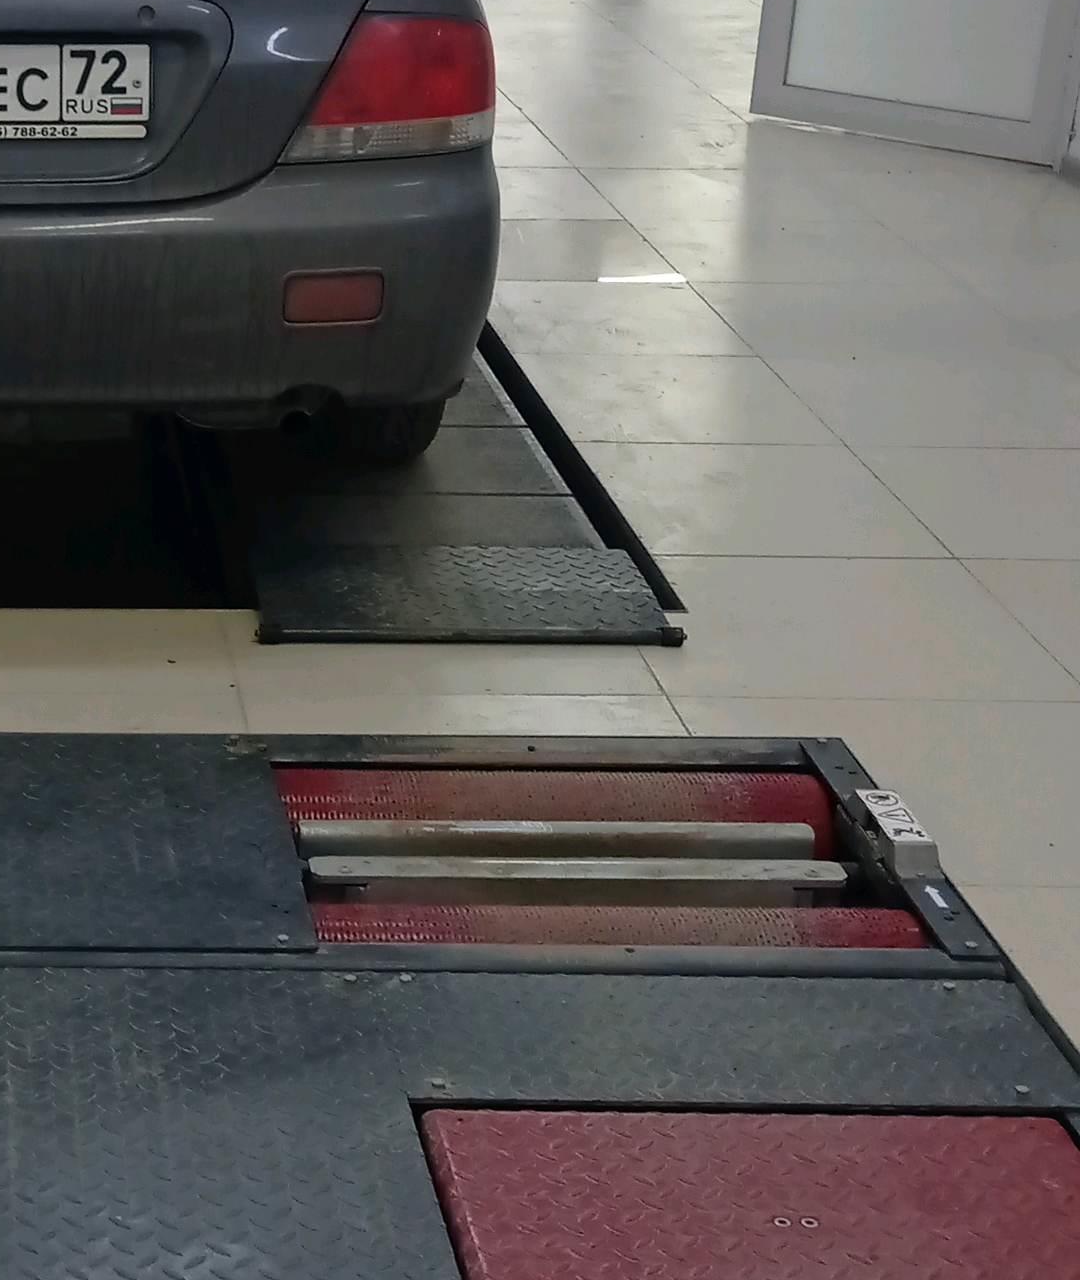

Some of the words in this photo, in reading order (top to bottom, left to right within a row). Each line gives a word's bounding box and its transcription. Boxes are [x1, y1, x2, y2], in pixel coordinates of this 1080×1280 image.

[70, 49, 127, 95] 72
[66, 99, 108, 115] RUS
[12, 126, 78, 137] 788-62-62
